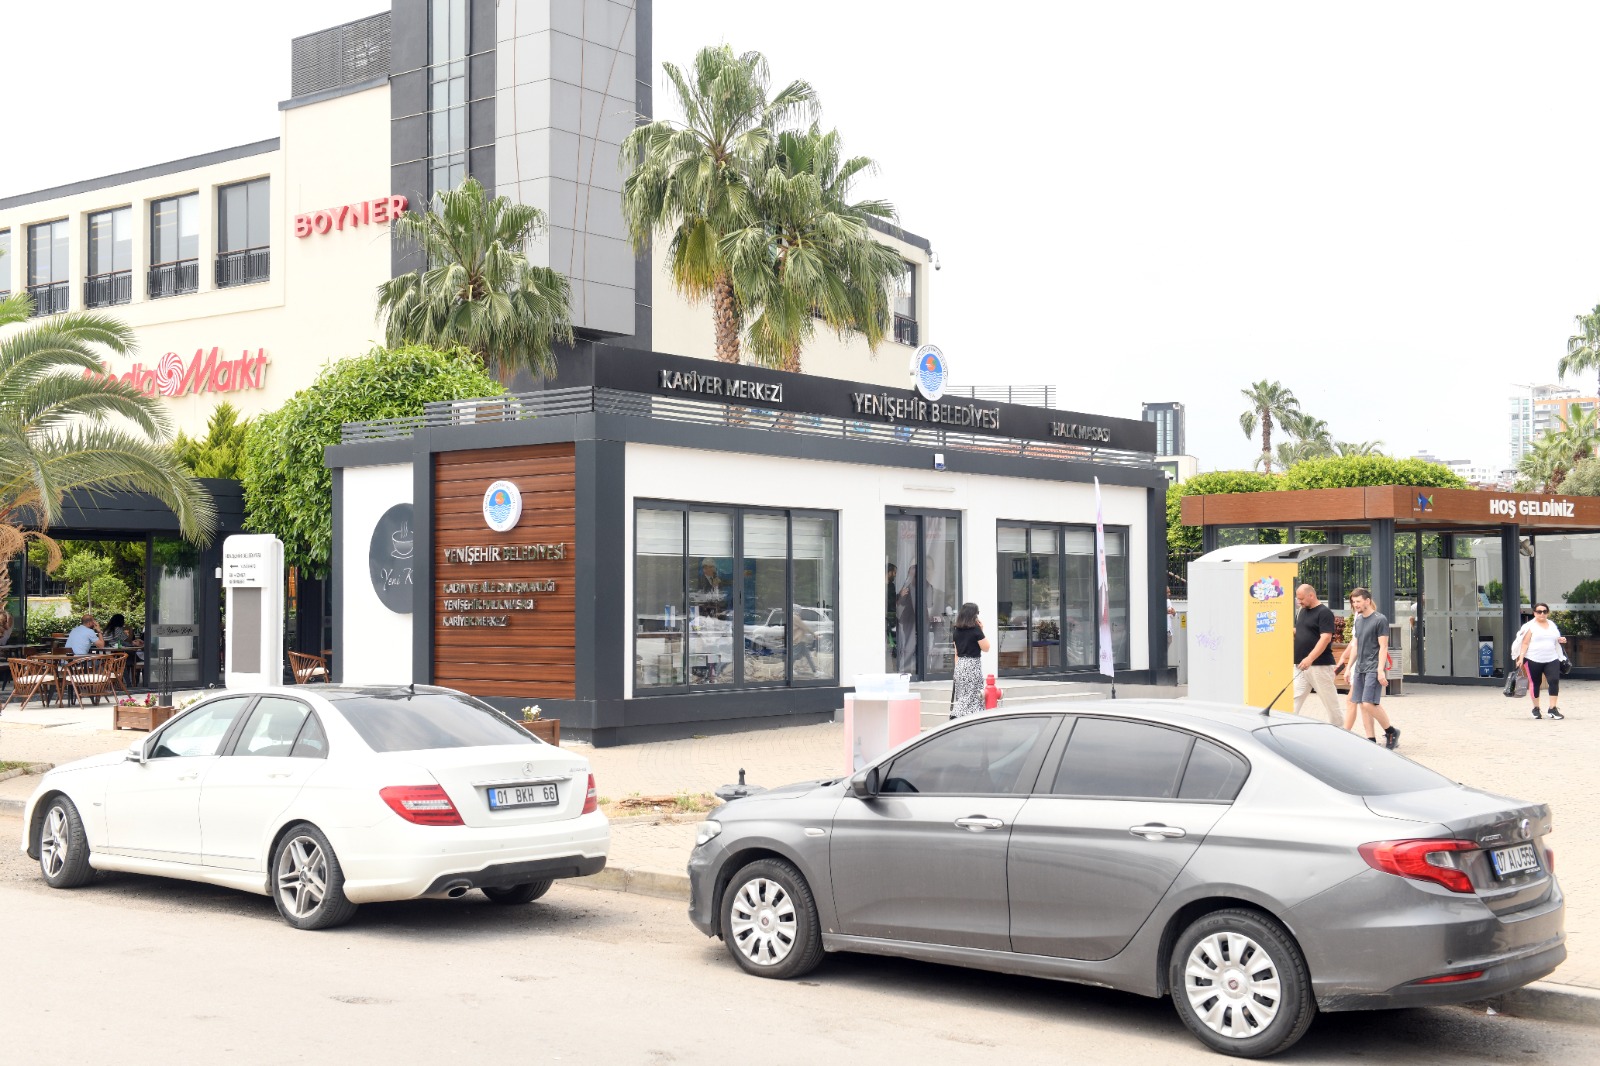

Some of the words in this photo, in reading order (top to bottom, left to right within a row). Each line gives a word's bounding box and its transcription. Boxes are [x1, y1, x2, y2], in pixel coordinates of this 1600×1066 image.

[294, 195, 409, 238] BOYNER
[177, 346, 267, 397] Markt
[659, 369, 722, 395] KARİYER
[726, 378, 783, 402] MERKEZİ
[853, 392, 928, 422] YENİŞEHİR
[931, 403, 1000, 430] BELEDİYESİ
[1052, 421, 1077, 438] HALK
[1078, 425, 1111, 442] MASASI
[1490, 499, 1516, 518] HOŞ
[1519, 499, 1574, 517] GELDİNİZ
[444, 545, 502, 565] YENİŞEHİR
[502, 542, 566, 560] BELEDİYESİ
[381, 568, 401, 591] Yeni
[497, 790, 508, 804] 01
[516, 788, 534, 803] BKH
[543, 786, 555, 800] 66
[1496, 851, 1507, 872] 07
